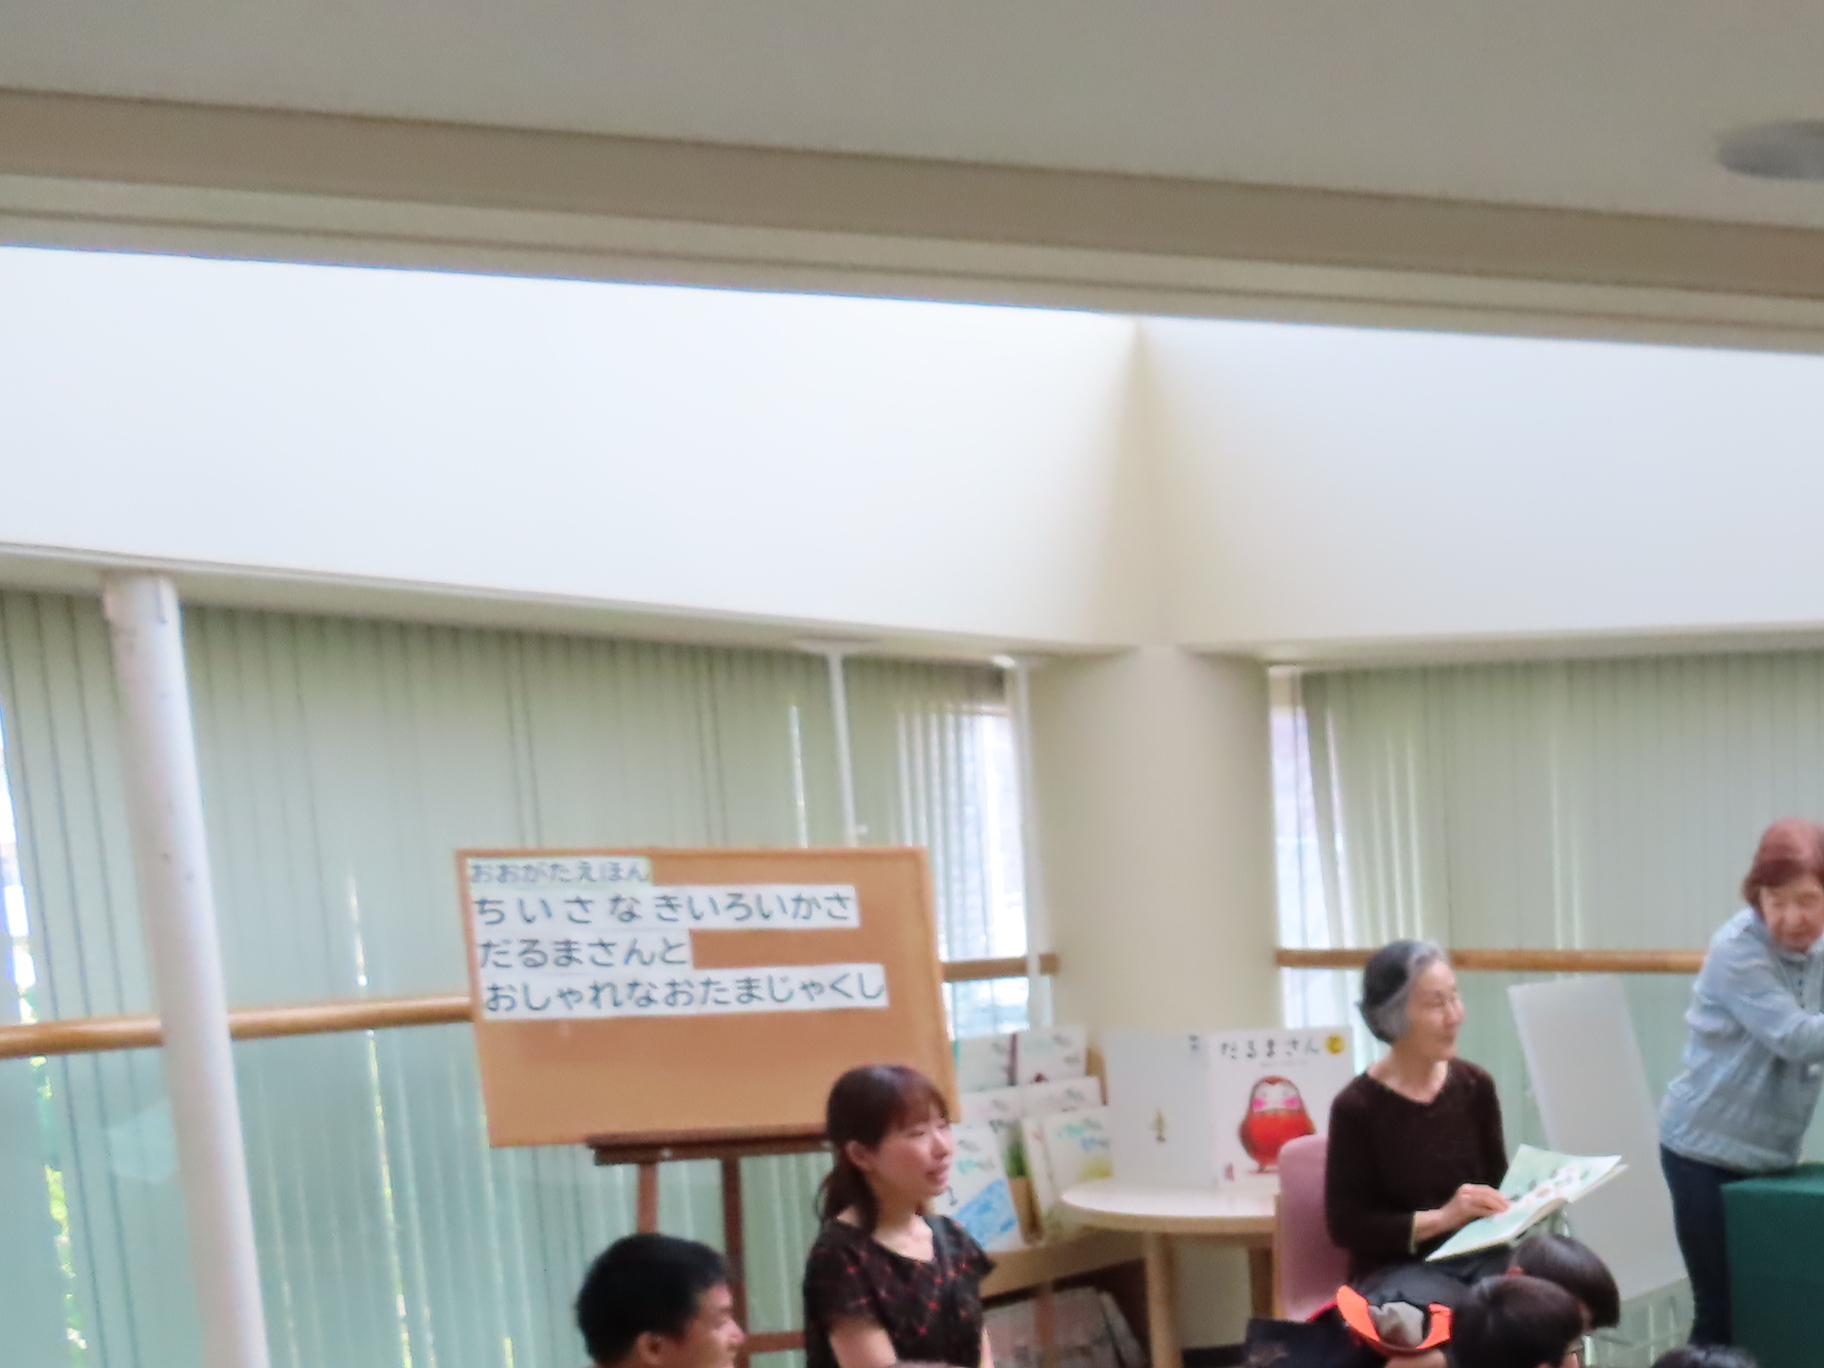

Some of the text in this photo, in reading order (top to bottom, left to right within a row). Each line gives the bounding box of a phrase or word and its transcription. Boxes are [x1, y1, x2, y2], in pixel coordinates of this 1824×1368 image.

[472, 861, 648, 883] おおがたえほん
[474, 892, 851, 925] ちいさなきいろいかさ
[480, 937, 687, 968] だるまさんと
[486, 972, 885, 1012] おしゃれなおたまじゃくし
